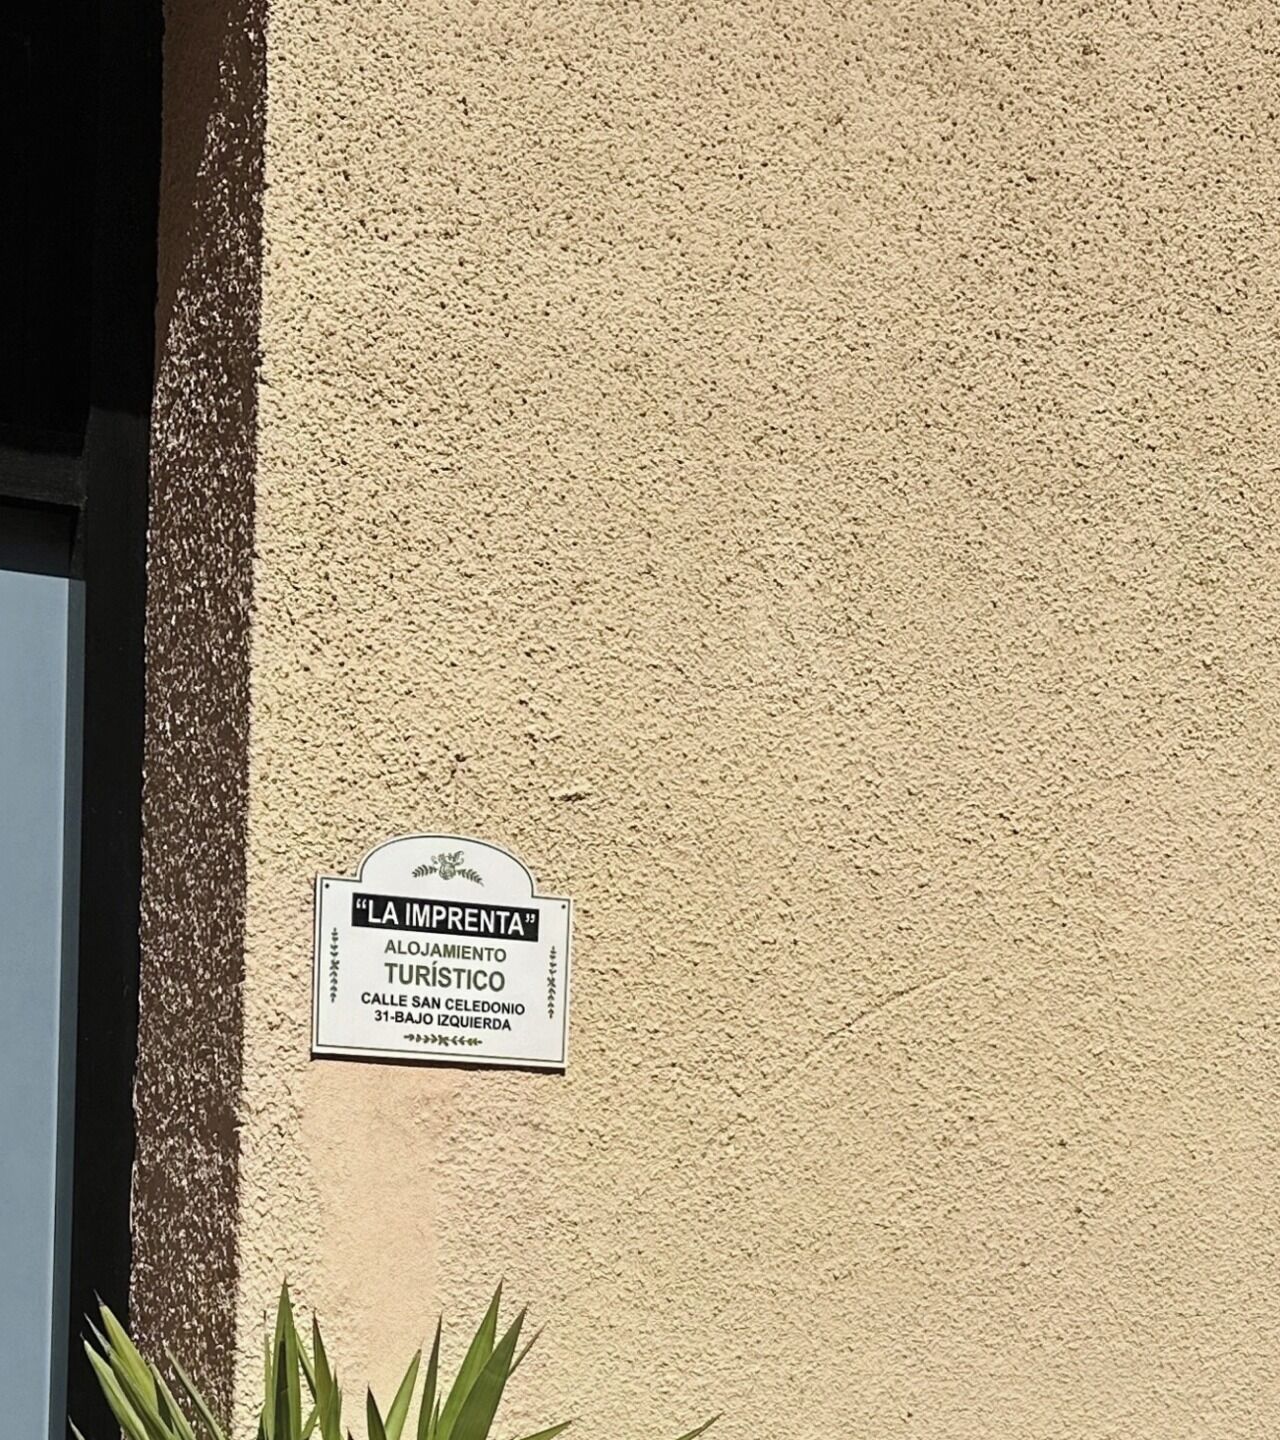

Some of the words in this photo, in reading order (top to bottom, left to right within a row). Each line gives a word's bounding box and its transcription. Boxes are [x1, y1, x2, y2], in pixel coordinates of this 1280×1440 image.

[384, 940, 506, 962] ALOJAMIENTO
[384, 962, 505, 992] TURÍSTICO
[361, 992, 407, 1007] CALLE
[412, 996, 441, 1010] SAN
[446, 998, 525, 1015] CELEDONIO
[374, 1010, 433, 1026] 31-BAJO
[437, 1016, 511, 1031] IZQUIERDA
